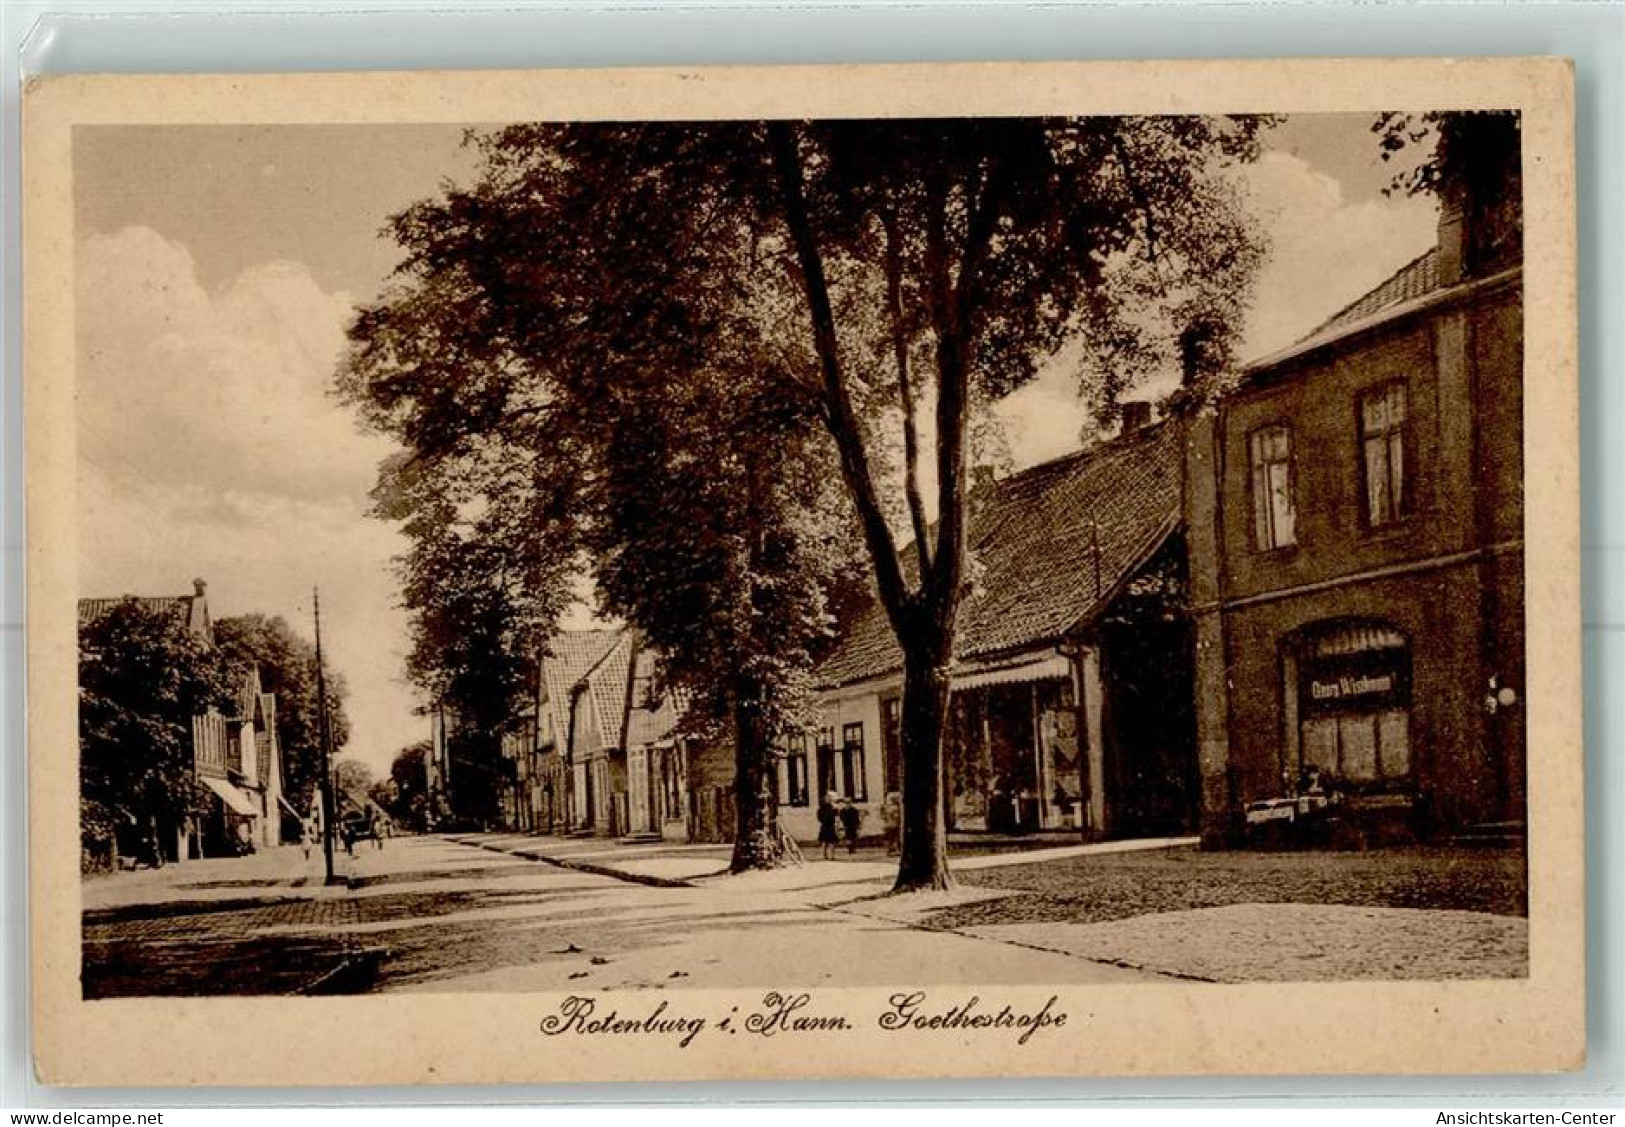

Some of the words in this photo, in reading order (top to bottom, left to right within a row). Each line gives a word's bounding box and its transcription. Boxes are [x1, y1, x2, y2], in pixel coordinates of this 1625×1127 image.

[539, 995, 706, 1049] Rotenburg
[715, 1006, 739, 1035] i.
[744, 991, 852, 1037] Hann.
